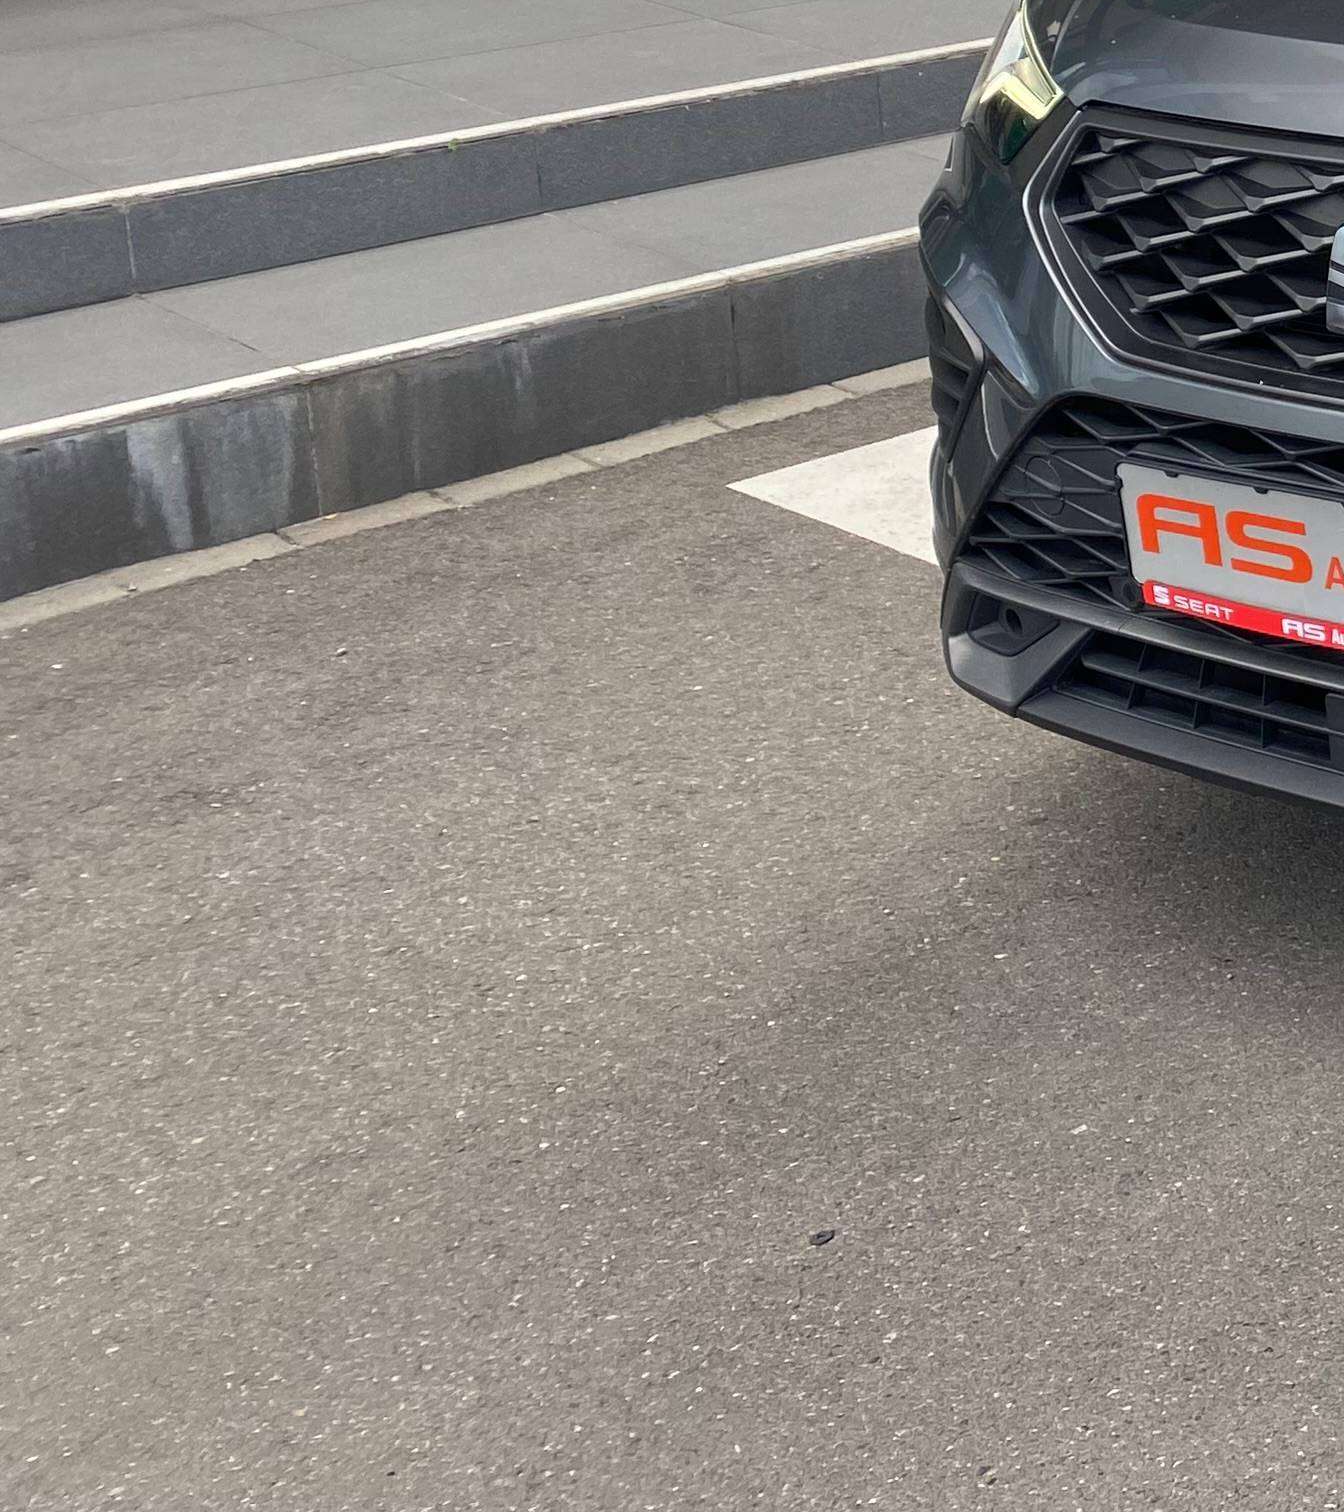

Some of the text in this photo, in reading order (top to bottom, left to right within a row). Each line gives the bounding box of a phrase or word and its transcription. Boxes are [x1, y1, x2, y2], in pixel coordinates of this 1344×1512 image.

[1136, 493, 1313, 584] AS
[1173, 595, 1234, 620] SEAT
[1281, 617, 1326, 642] AS
